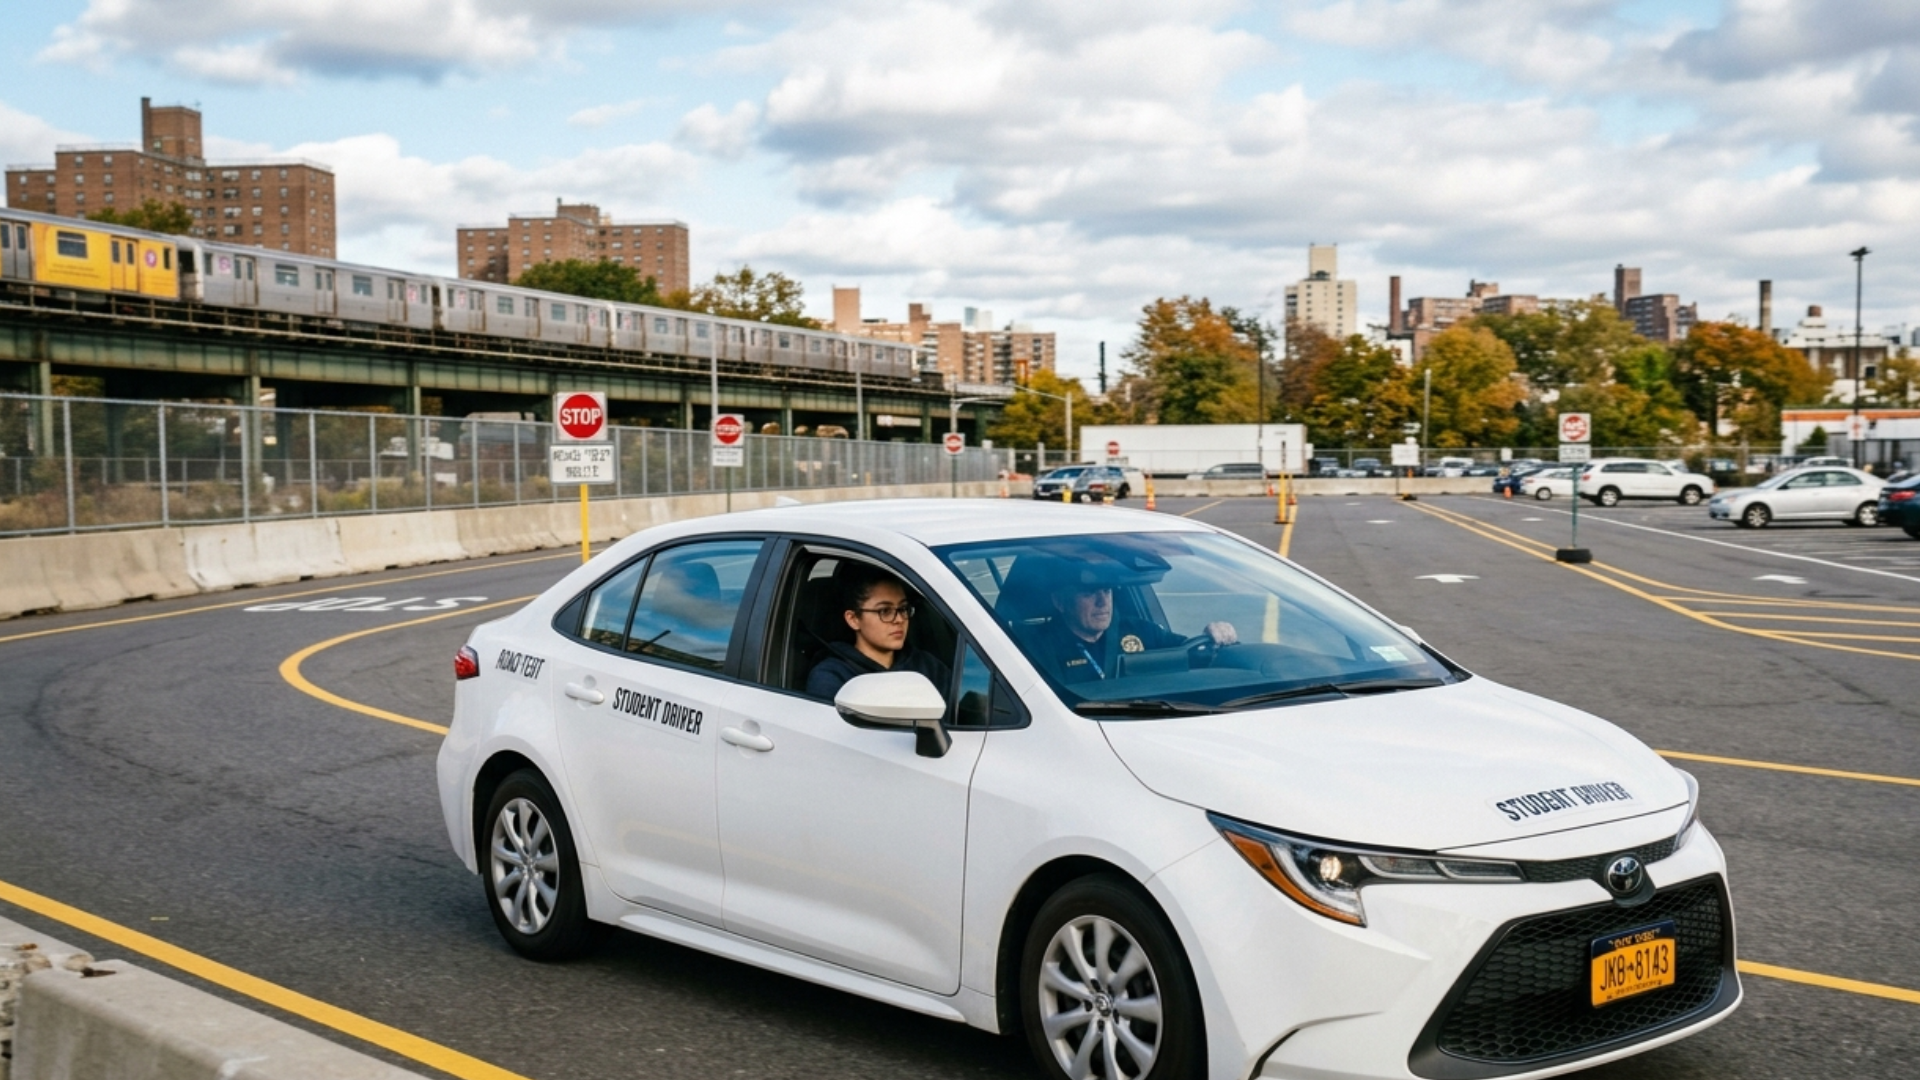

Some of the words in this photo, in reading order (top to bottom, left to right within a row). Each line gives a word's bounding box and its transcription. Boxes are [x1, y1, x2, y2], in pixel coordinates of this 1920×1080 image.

[561, 408, 601, 425] STOP
[612, 686, 662, 721] STUDENT
[1495, 788, 1578, 821] STUDENT
